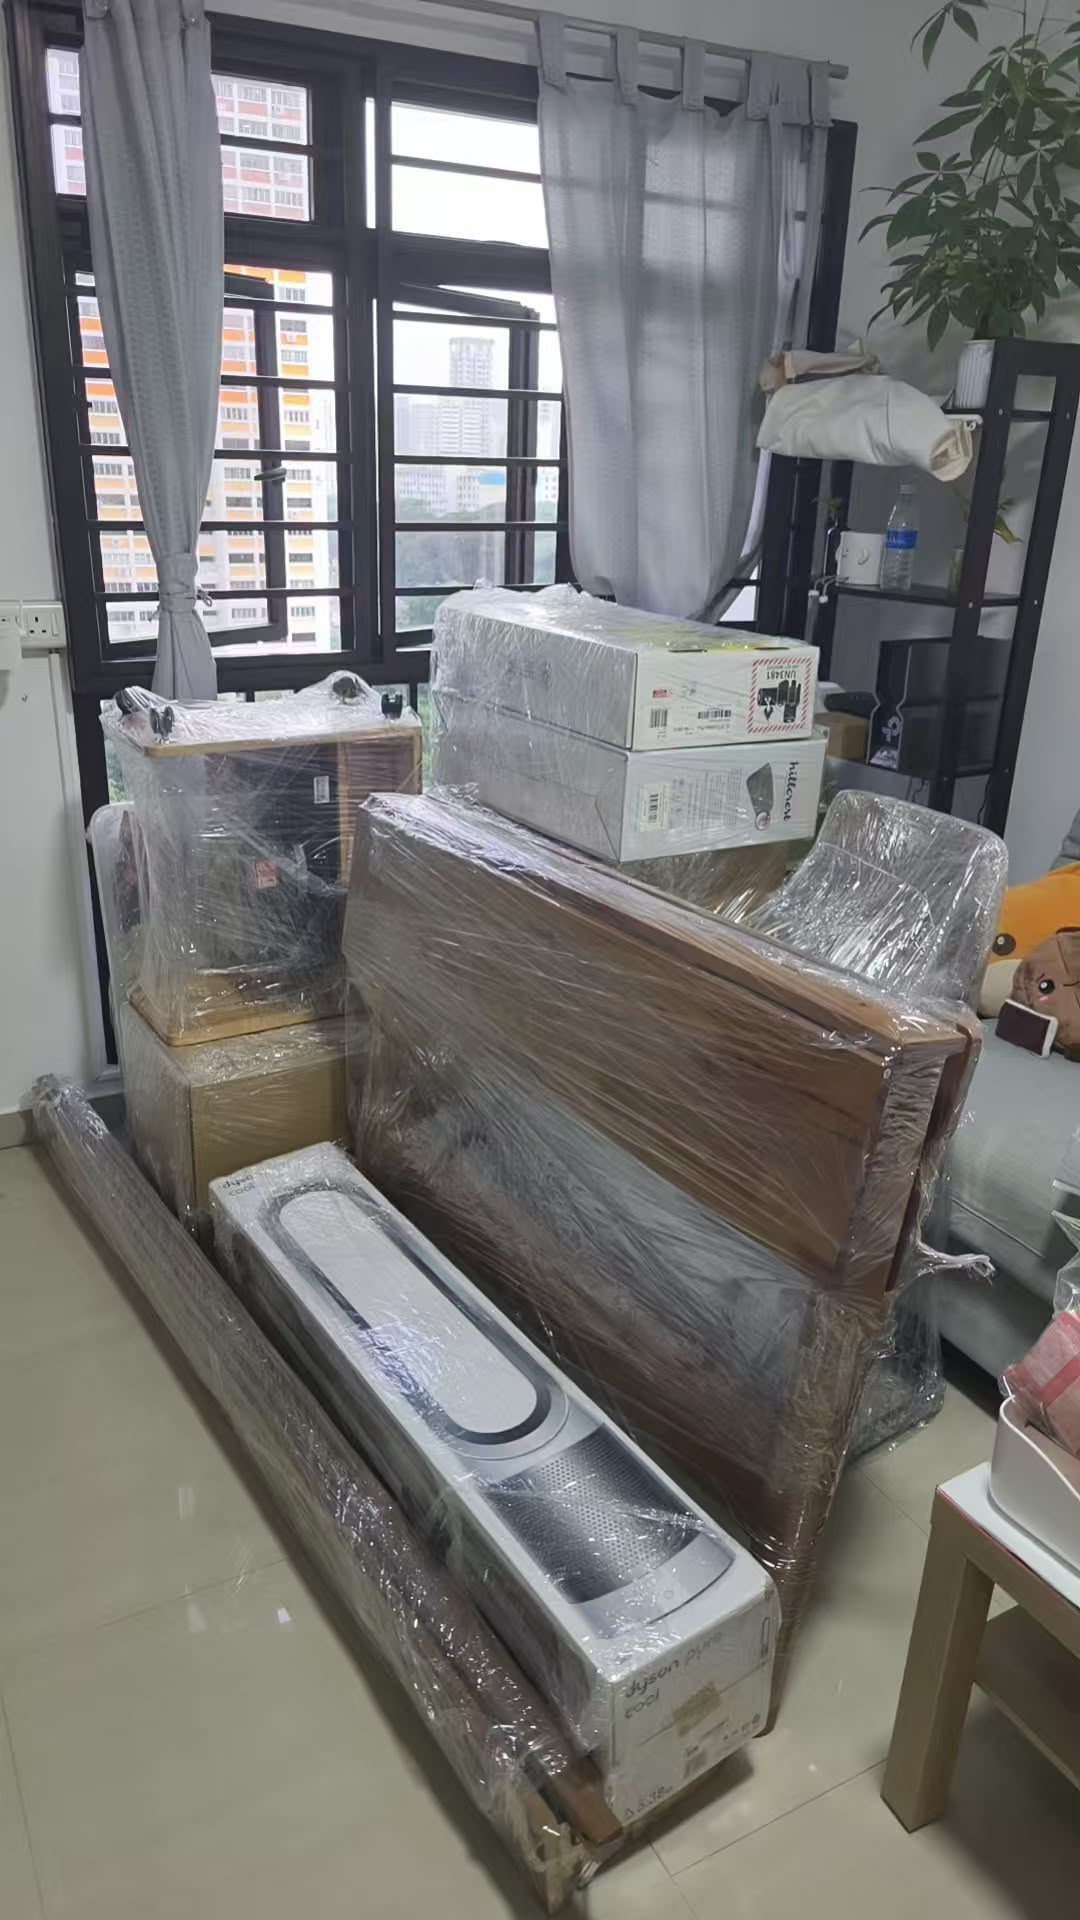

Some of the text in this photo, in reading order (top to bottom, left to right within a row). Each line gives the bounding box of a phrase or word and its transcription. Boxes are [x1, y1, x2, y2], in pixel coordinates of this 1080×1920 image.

[766, 670, 797, 681] UN3481
[783, 761, 800, 822] hillcrest
[223, 1173, 260, 1188] dyso
[625, 1660, 679, 1698] dyson
[624, 1688, 660, 1719] cool
